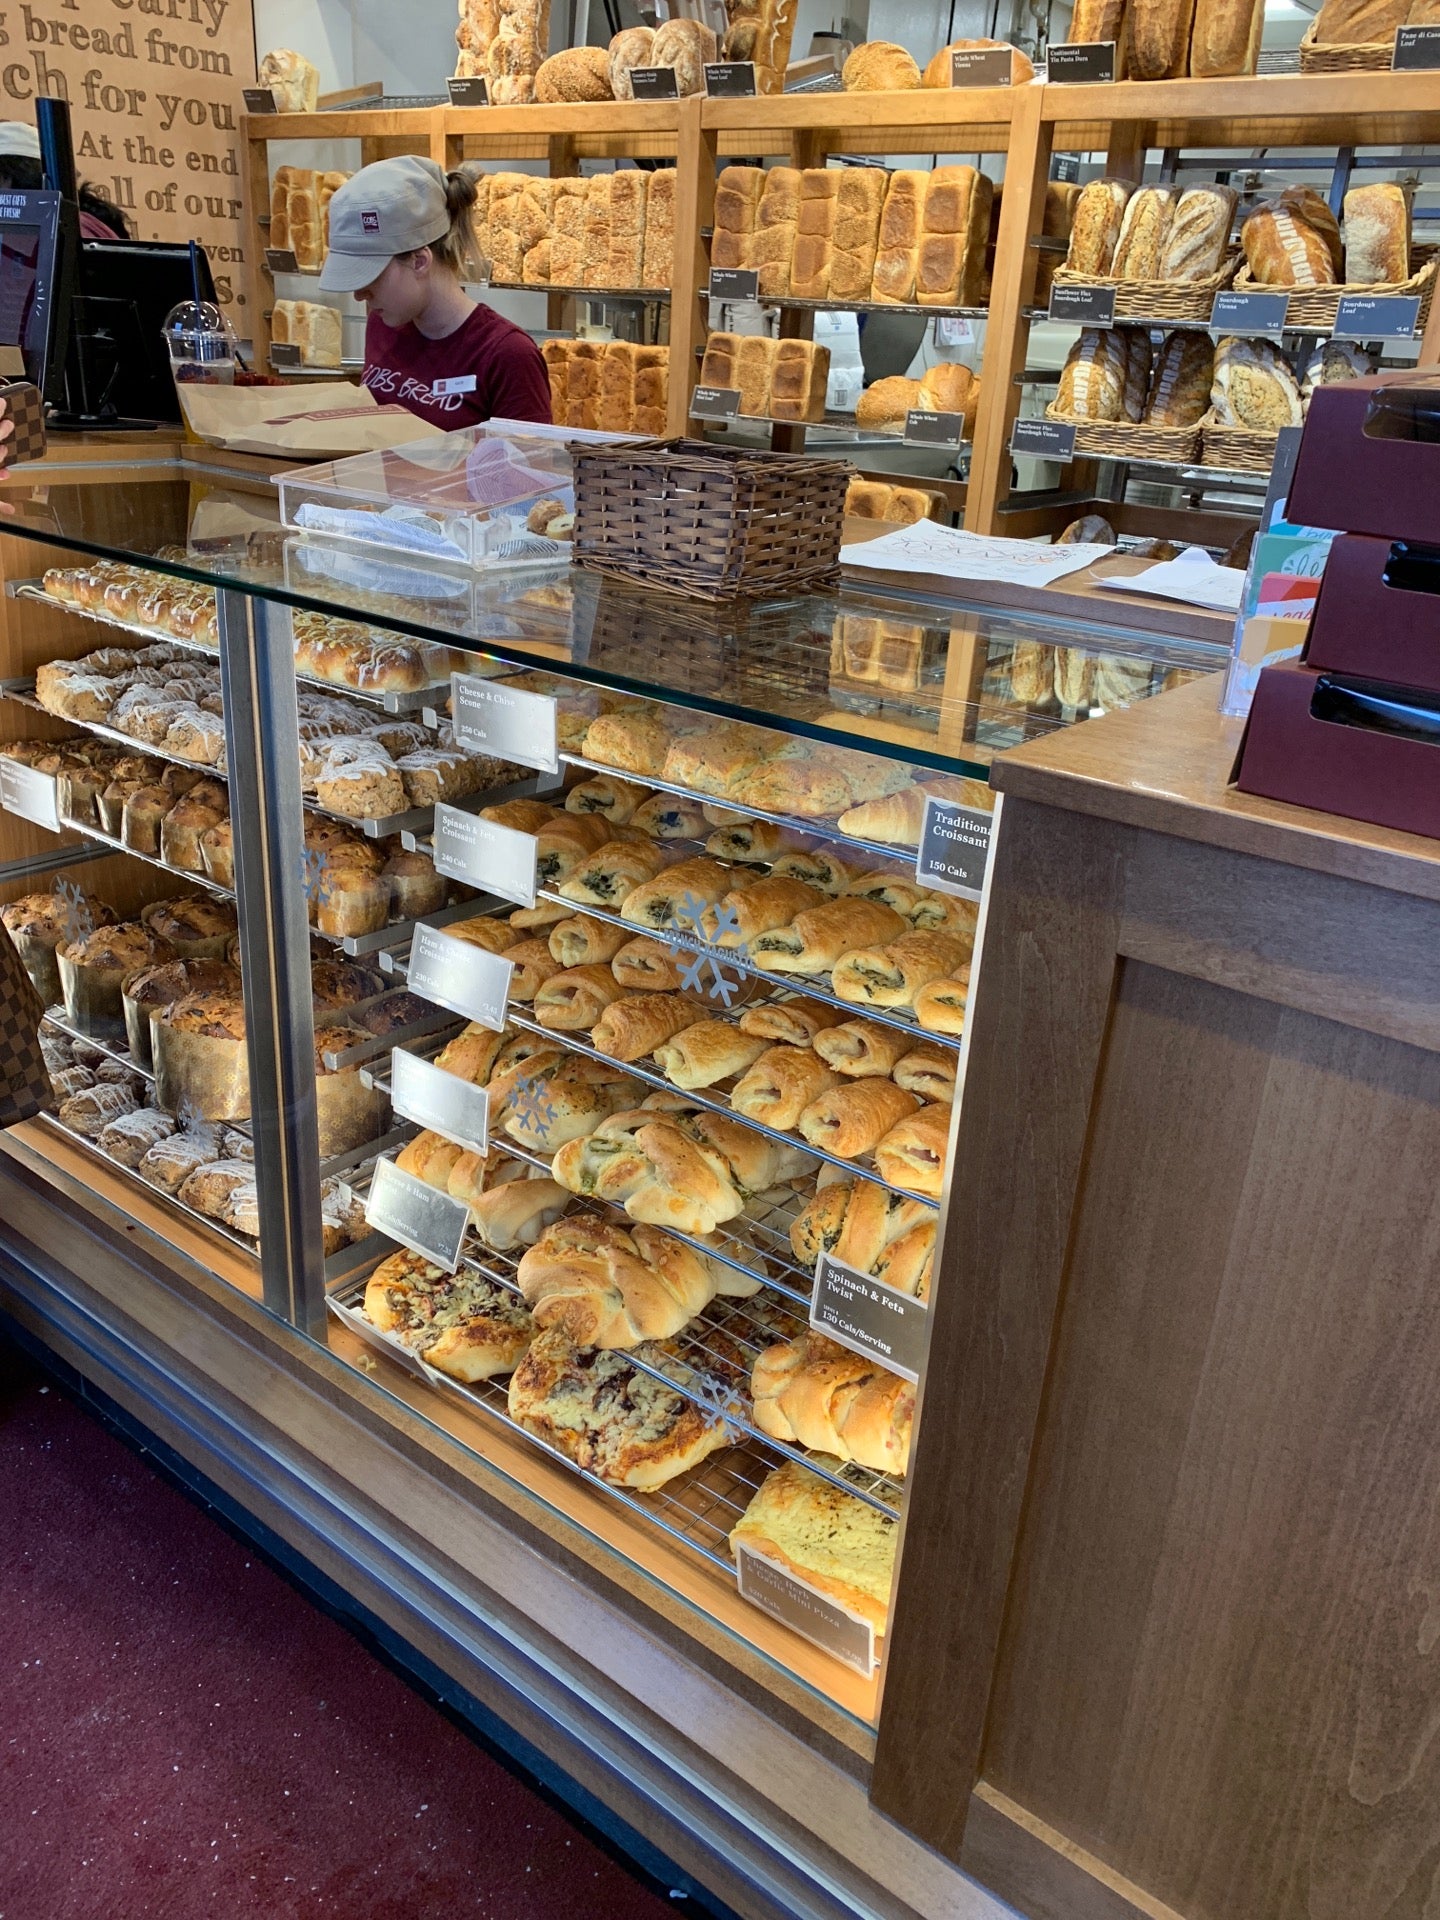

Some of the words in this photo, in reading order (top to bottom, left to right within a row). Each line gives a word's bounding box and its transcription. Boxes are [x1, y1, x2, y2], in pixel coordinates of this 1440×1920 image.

[20, 4, 138, 59] bread
[144, 28, 233, 76] from
[81, 69, 146, 116] for
[156, 94, 237, 131] you
[77, 130, 113, 160] At
[123, 135, 175, 168] the
[185, 149, 240, 176] end
[144, 182, 178, 213] of
[184, 194, 243, 220] our
[1343, 301, 1376, 309] Sourdough
[459, 685, 485, 700] Cheese
[486, 691, 493, 701] &
[493, 694, 515, 707] Chive
[459, 696, 481, 709] Scone
[473, 728, 487, 738] Cals
[442, 816, 471, 833] Spinach
[471, 827, 477, 835] &
[935, 811, 991, 836] Traditiona
[442, 826, 476, 845] Croissant
[933, 825, 988, 848] Croissant
[441, 853, 453, 864] 240
[453, 857, 466, 868] Cals
[930, 860, 946, 872] 150
[947, 865, 968, 878] Cals
[421, 935, 438, 948] Ham
[413, 1187, 430, 1202] Ham
[827, 1280, 854, 1301] Twist
[827, 1269, 868, 1297] Spinach
[870, 1291, 879, 1302] &
[881, 1296, 905, 1315] Feta
[822, 1310, 838, 1324] 130
[839, 1319, 893, 1355] Cals/Serving
[788, 1590, 811, 1609] Mini
[814, 1606, 840, 1628] Pizza
